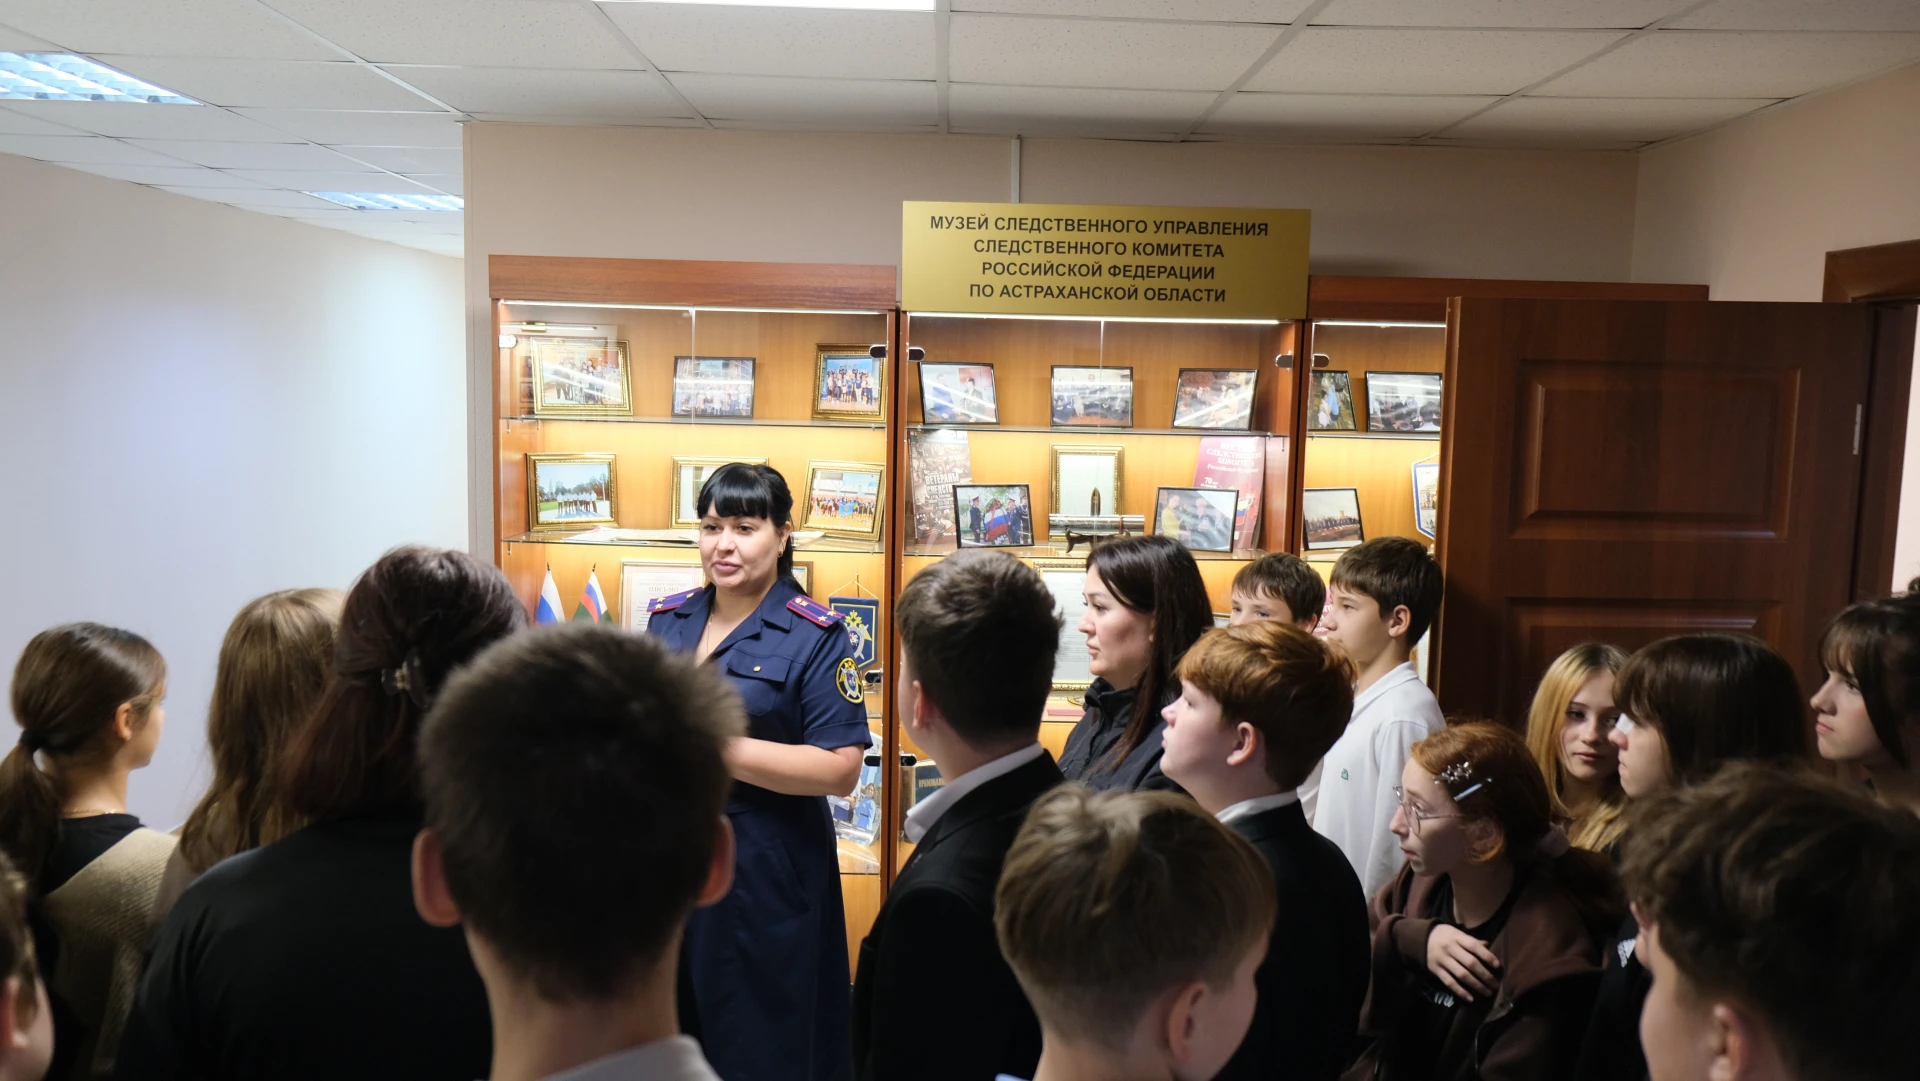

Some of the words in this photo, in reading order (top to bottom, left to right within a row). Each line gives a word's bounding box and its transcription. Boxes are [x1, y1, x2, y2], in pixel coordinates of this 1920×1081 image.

[930, 215, 989, 231] МУЗЕЙ
[994, 217, 1148, 234] СЛЕДСТВЕННОГО
[1153, 220, 1269, 237] УПРАВЛЕНИЯ
[973, 239, 1127, 256] СЛЕДСТВЕННОГО
[1132, 242, 1225, 258] КОМИТЕТА
[982, 260, 1103, 278] РОССИЙСКОЙ
[1107, 264, 1215, 282] ФЕДЕРАЦИИ
[969, 284, 995, 298] ПО
[1000, 284, 1139, 301] АСТРАХАНСКОЙ
[1144, 287, 1226, 303] ОБЛАСТИ
[925, 473, 959, 485] ВЕТЕРАНЫ
[926, 484, 953, 495] СЛЕДСТВ
